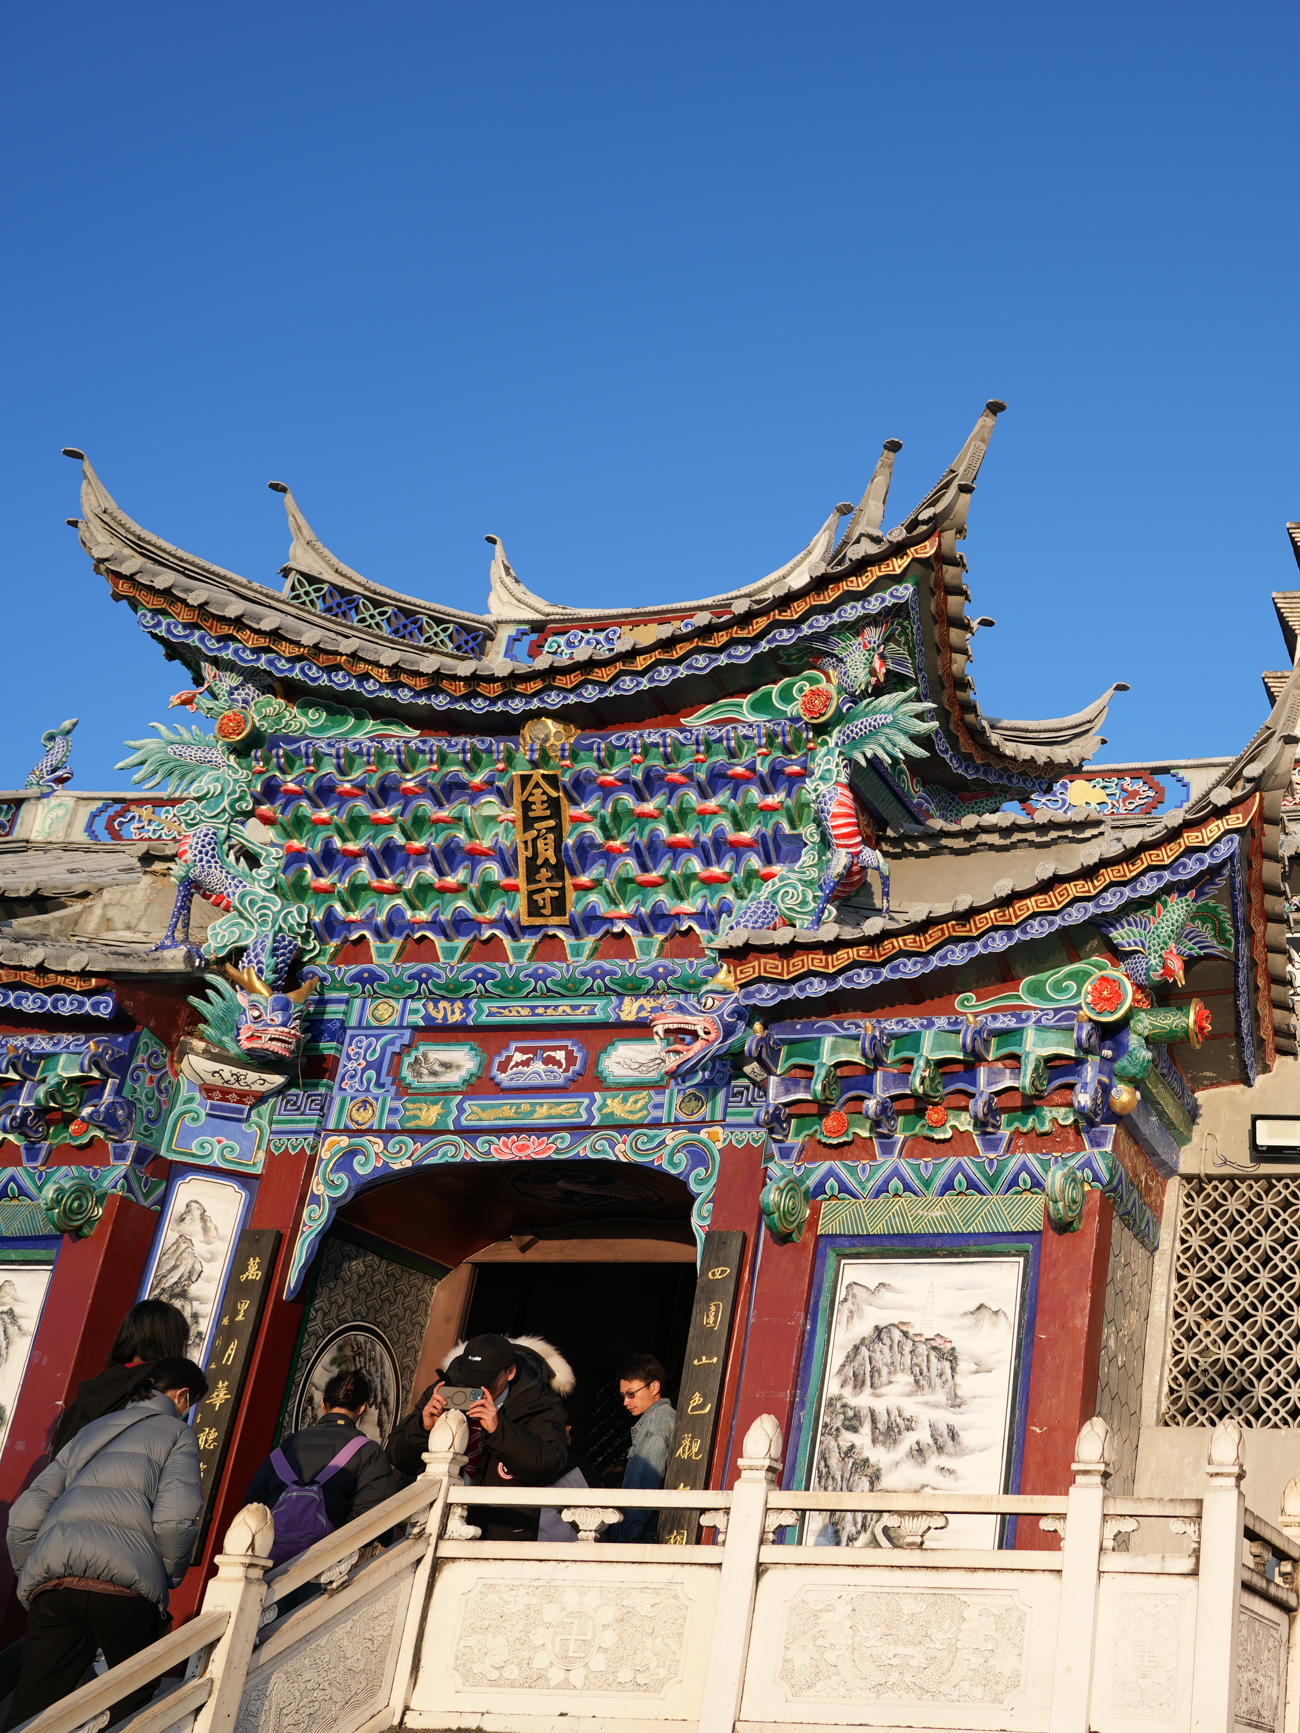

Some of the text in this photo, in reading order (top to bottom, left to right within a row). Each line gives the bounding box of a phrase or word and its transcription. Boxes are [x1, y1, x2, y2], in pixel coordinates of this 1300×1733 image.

[521, 770, 563, 916] 金頂寺
[197, 1257, 262, 1480] 萬里月華聽
[665, 1266, 731, 1545] 四圍山色觀相
